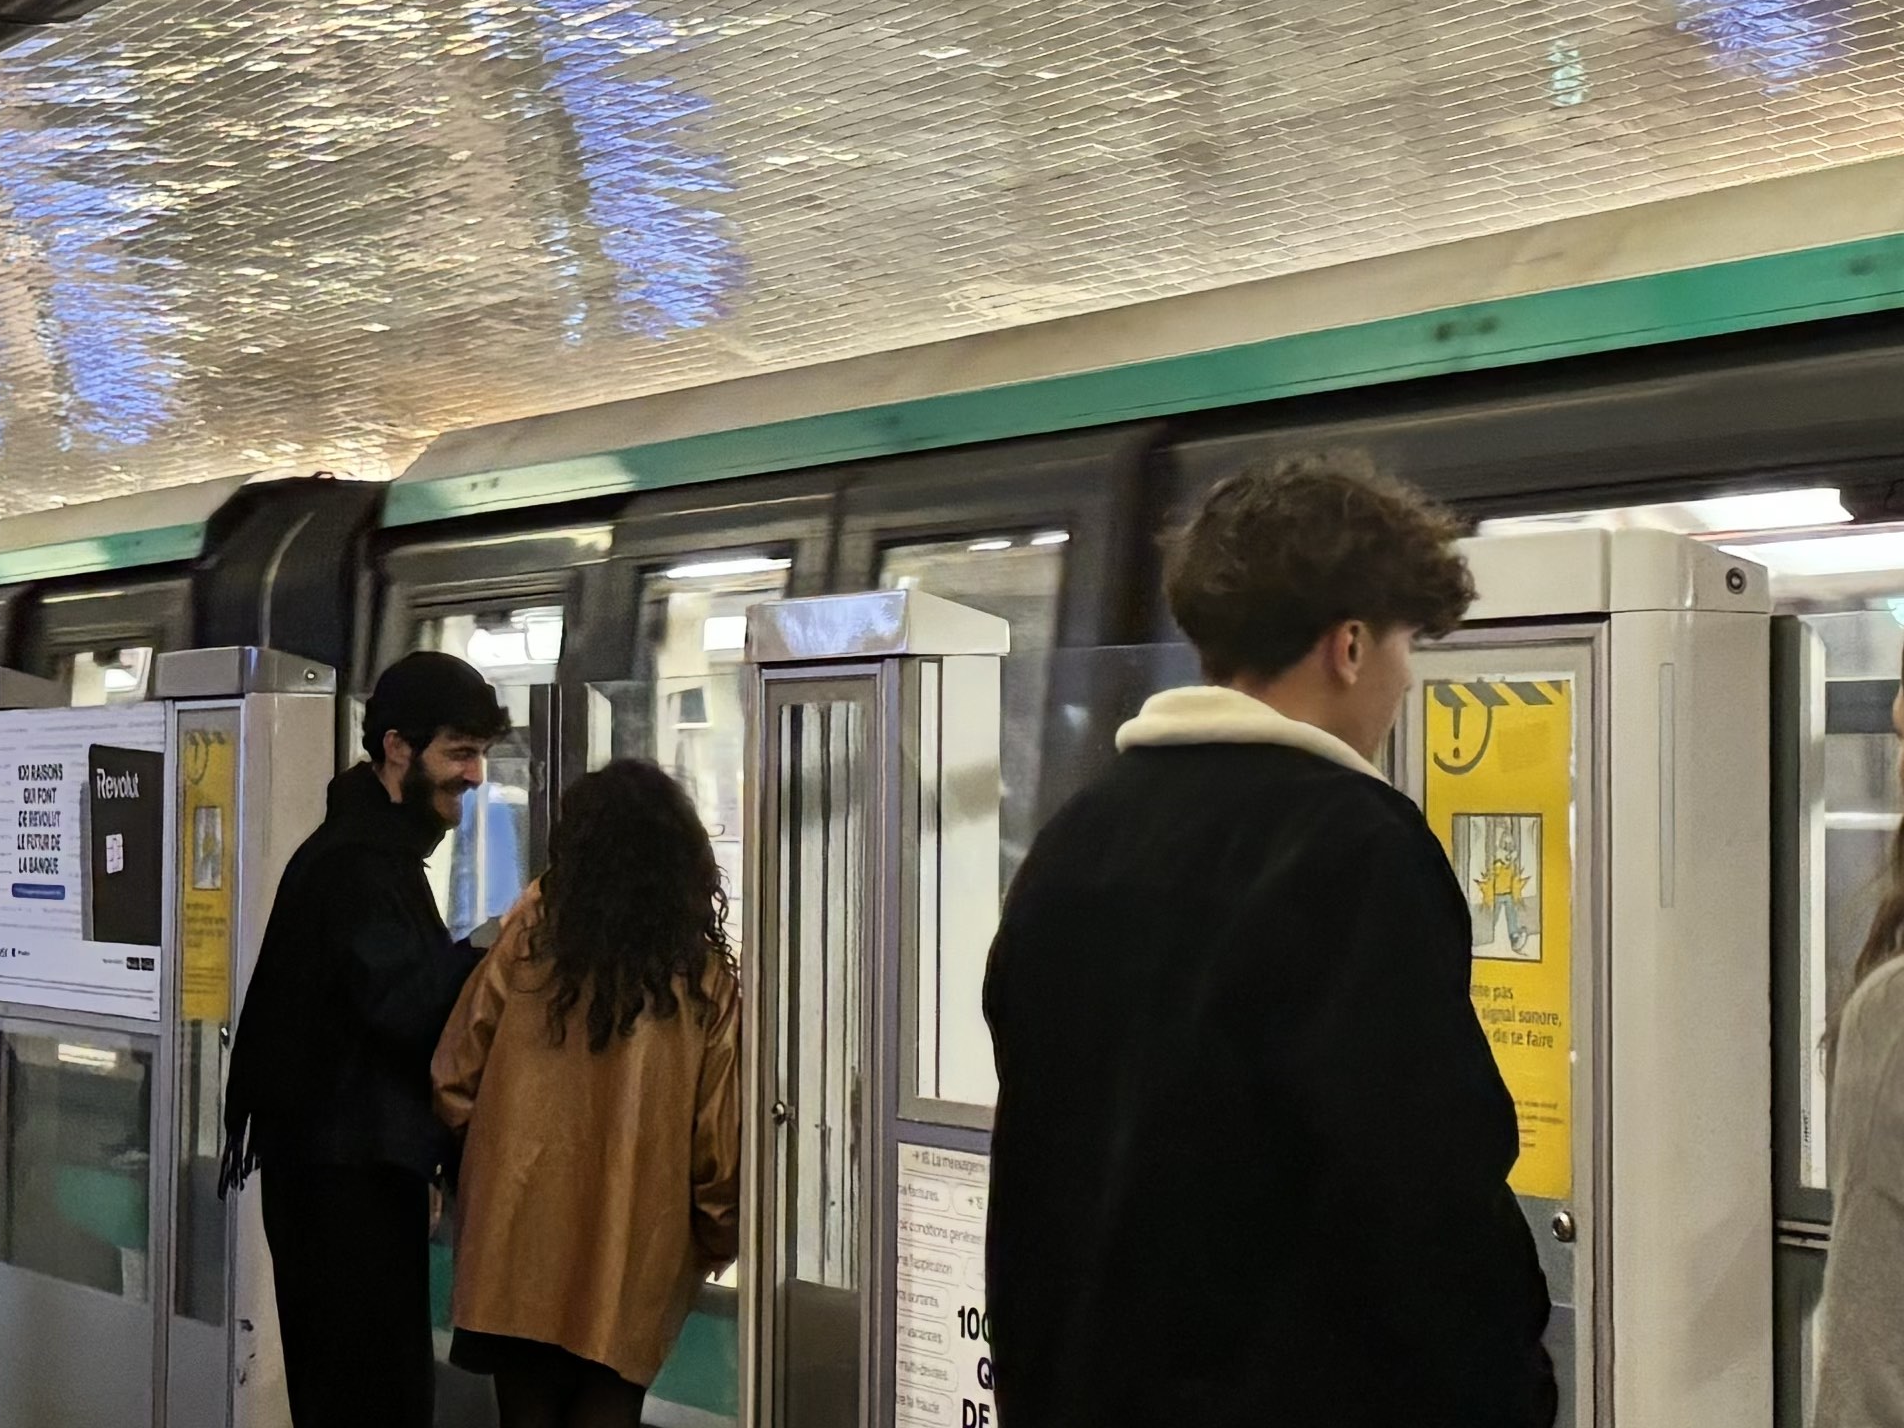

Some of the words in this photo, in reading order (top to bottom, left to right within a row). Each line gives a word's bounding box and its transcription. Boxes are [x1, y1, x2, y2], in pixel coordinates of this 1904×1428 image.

[30, 763, 64, 781] RAISONS
[96, 768, 140, 799] Revolut
[37, 787, 57, 804] FONT
[29, 810, 62, 827] REVOLUT
[28, 857, 59, 875] BANQUE
[1492, 987, 1514, 1001] pas
[1518, 1010, 1563, 1028] sonore,
[1511, 1031, 1524, 1046] te
[1526, 1030, 1554, 1048] faire
